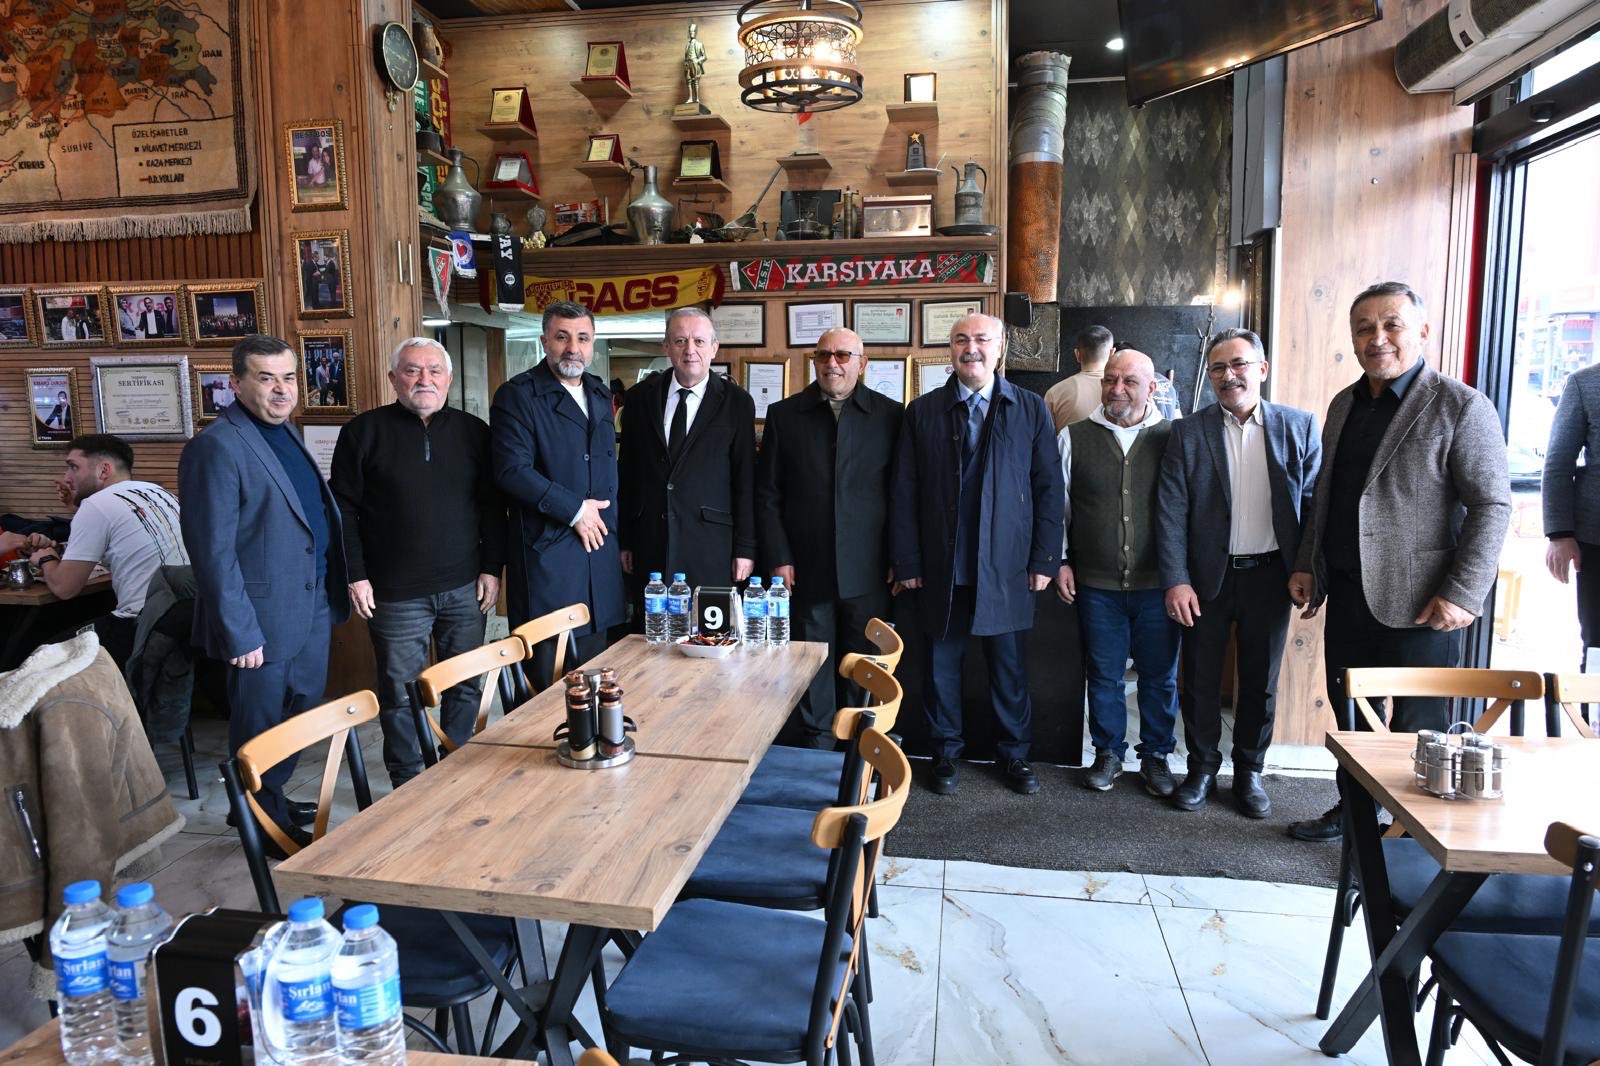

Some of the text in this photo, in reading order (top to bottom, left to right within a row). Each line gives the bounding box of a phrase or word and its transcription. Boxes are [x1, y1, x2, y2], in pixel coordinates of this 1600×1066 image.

[568, 275, 680, 313] GAGS
[703, 605, 724, 630] 9
[174, 986, 222, 1047] 6
